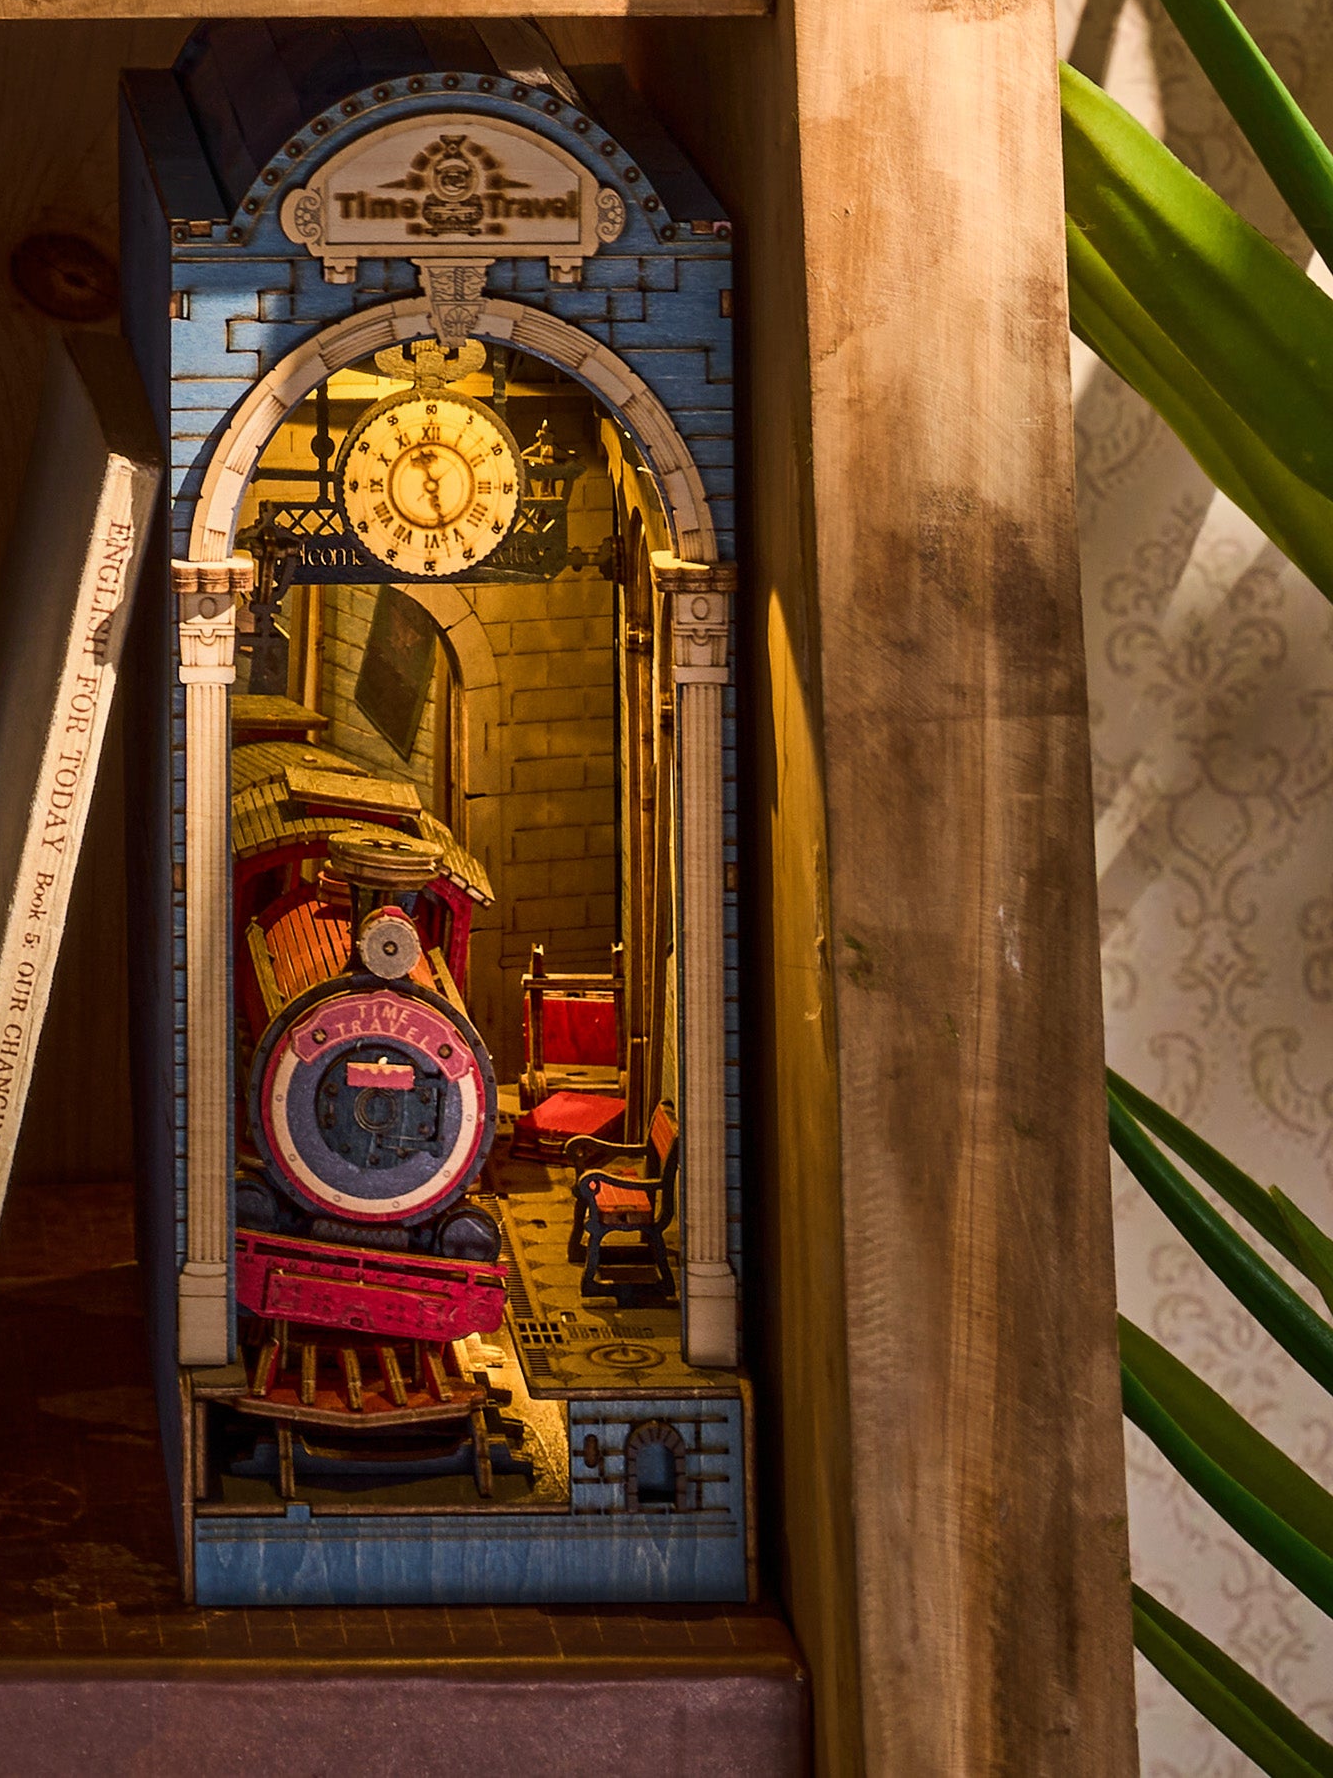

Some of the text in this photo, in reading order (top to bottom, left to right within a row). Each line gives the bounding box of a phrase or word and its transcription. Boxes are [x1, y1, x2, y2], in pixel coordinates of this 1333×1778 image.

[334, 189, 581, 220] Time Travel
[81, 520, 133, 658] ENGLISH
[64, 673, 101, 736] FOR
[40, 747, 86, 857] TODAY
[26, 868, 56, 923] Book
[21, 930, 43, 952] 5:
[7, 960, 37, 1015] OUR
[357, 1004, 412, 1025] TIME
[335, 1019, 431, 1049] TRAVEL
